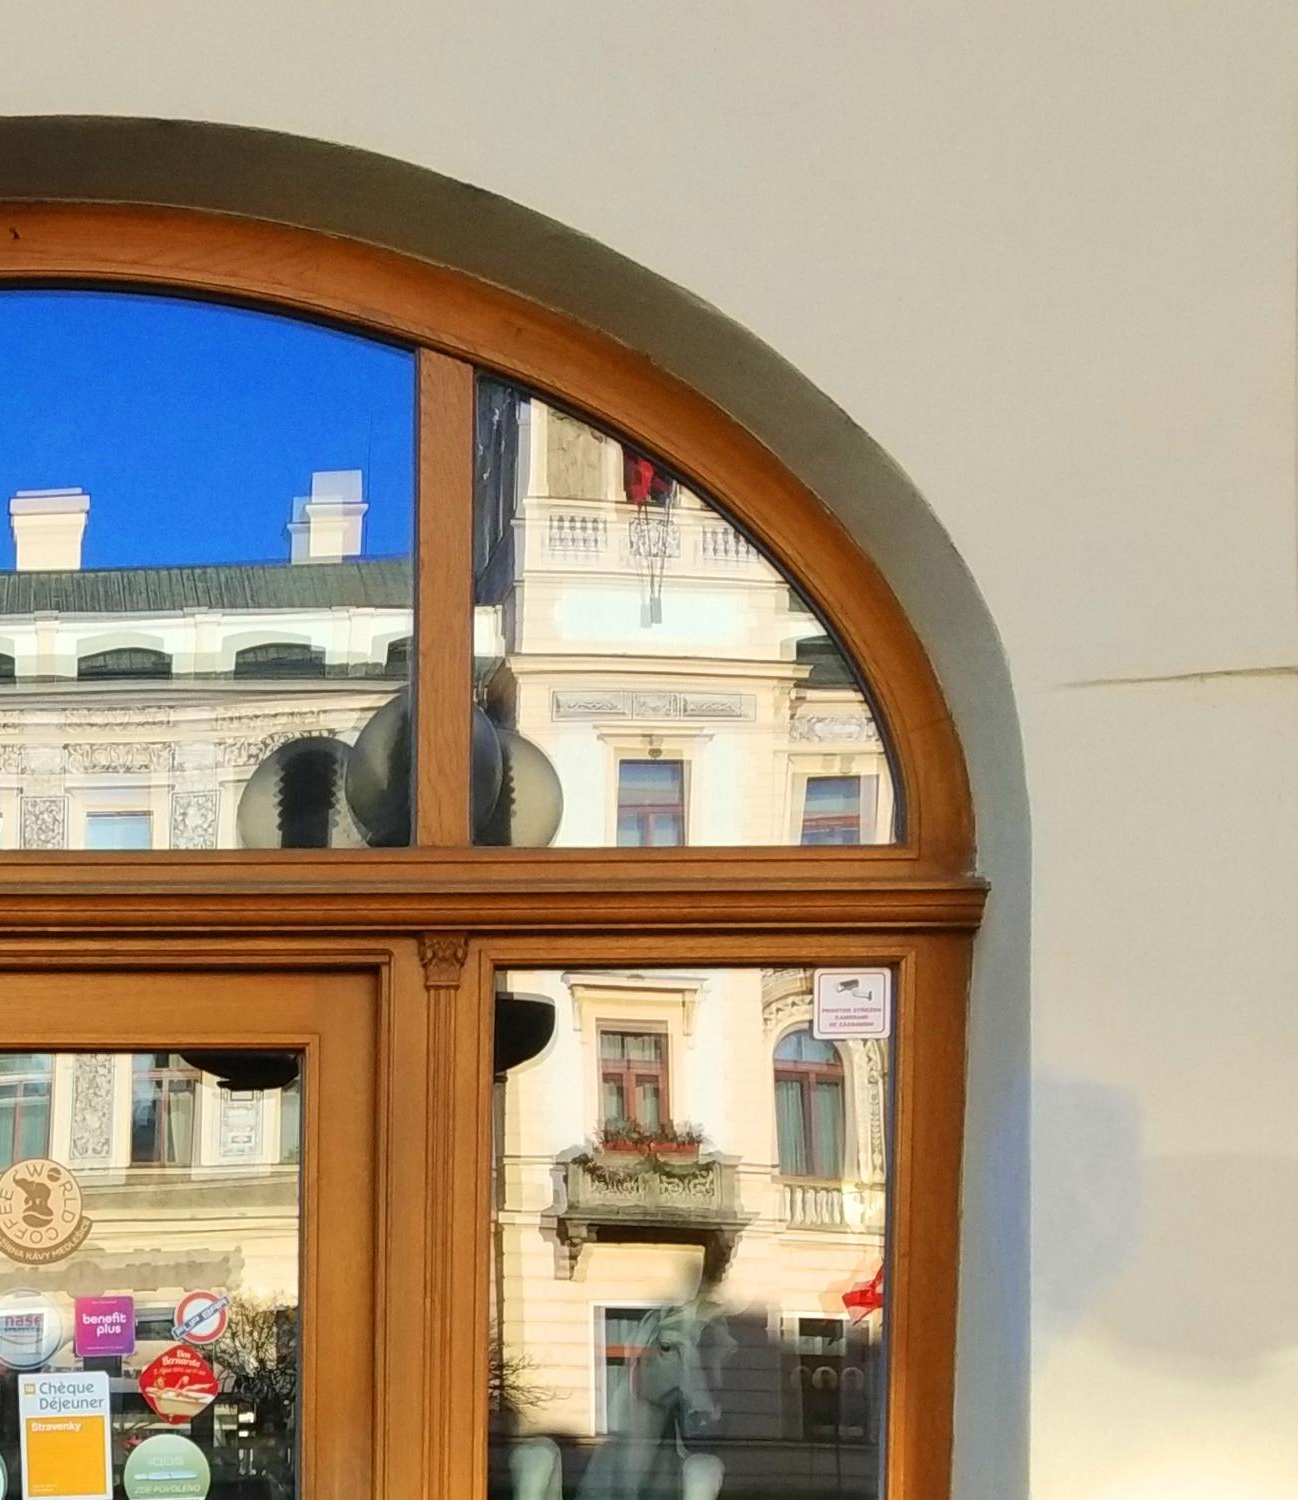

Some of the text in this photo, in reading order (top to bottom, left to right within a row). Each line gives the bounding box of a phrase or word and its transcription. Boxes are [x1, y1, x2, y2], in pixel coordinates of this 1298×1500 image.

[0, 1163, 77, 1245] COFFEE WORLD
[25, 1249, 51, 1261] KÁVY
[82, 1312, 126, 1325] benefit
[97, 1323, 121, 1337] plus
[39, 1381, 94, 1398] Chèque
[39, 1397, 104, 1412] Déjeuner
[31, 1422, 81, 1432] Stravenky
[150, 1456, 184, 1467] IQOS
[153, 1484, 201, 1494] POVOLENO
